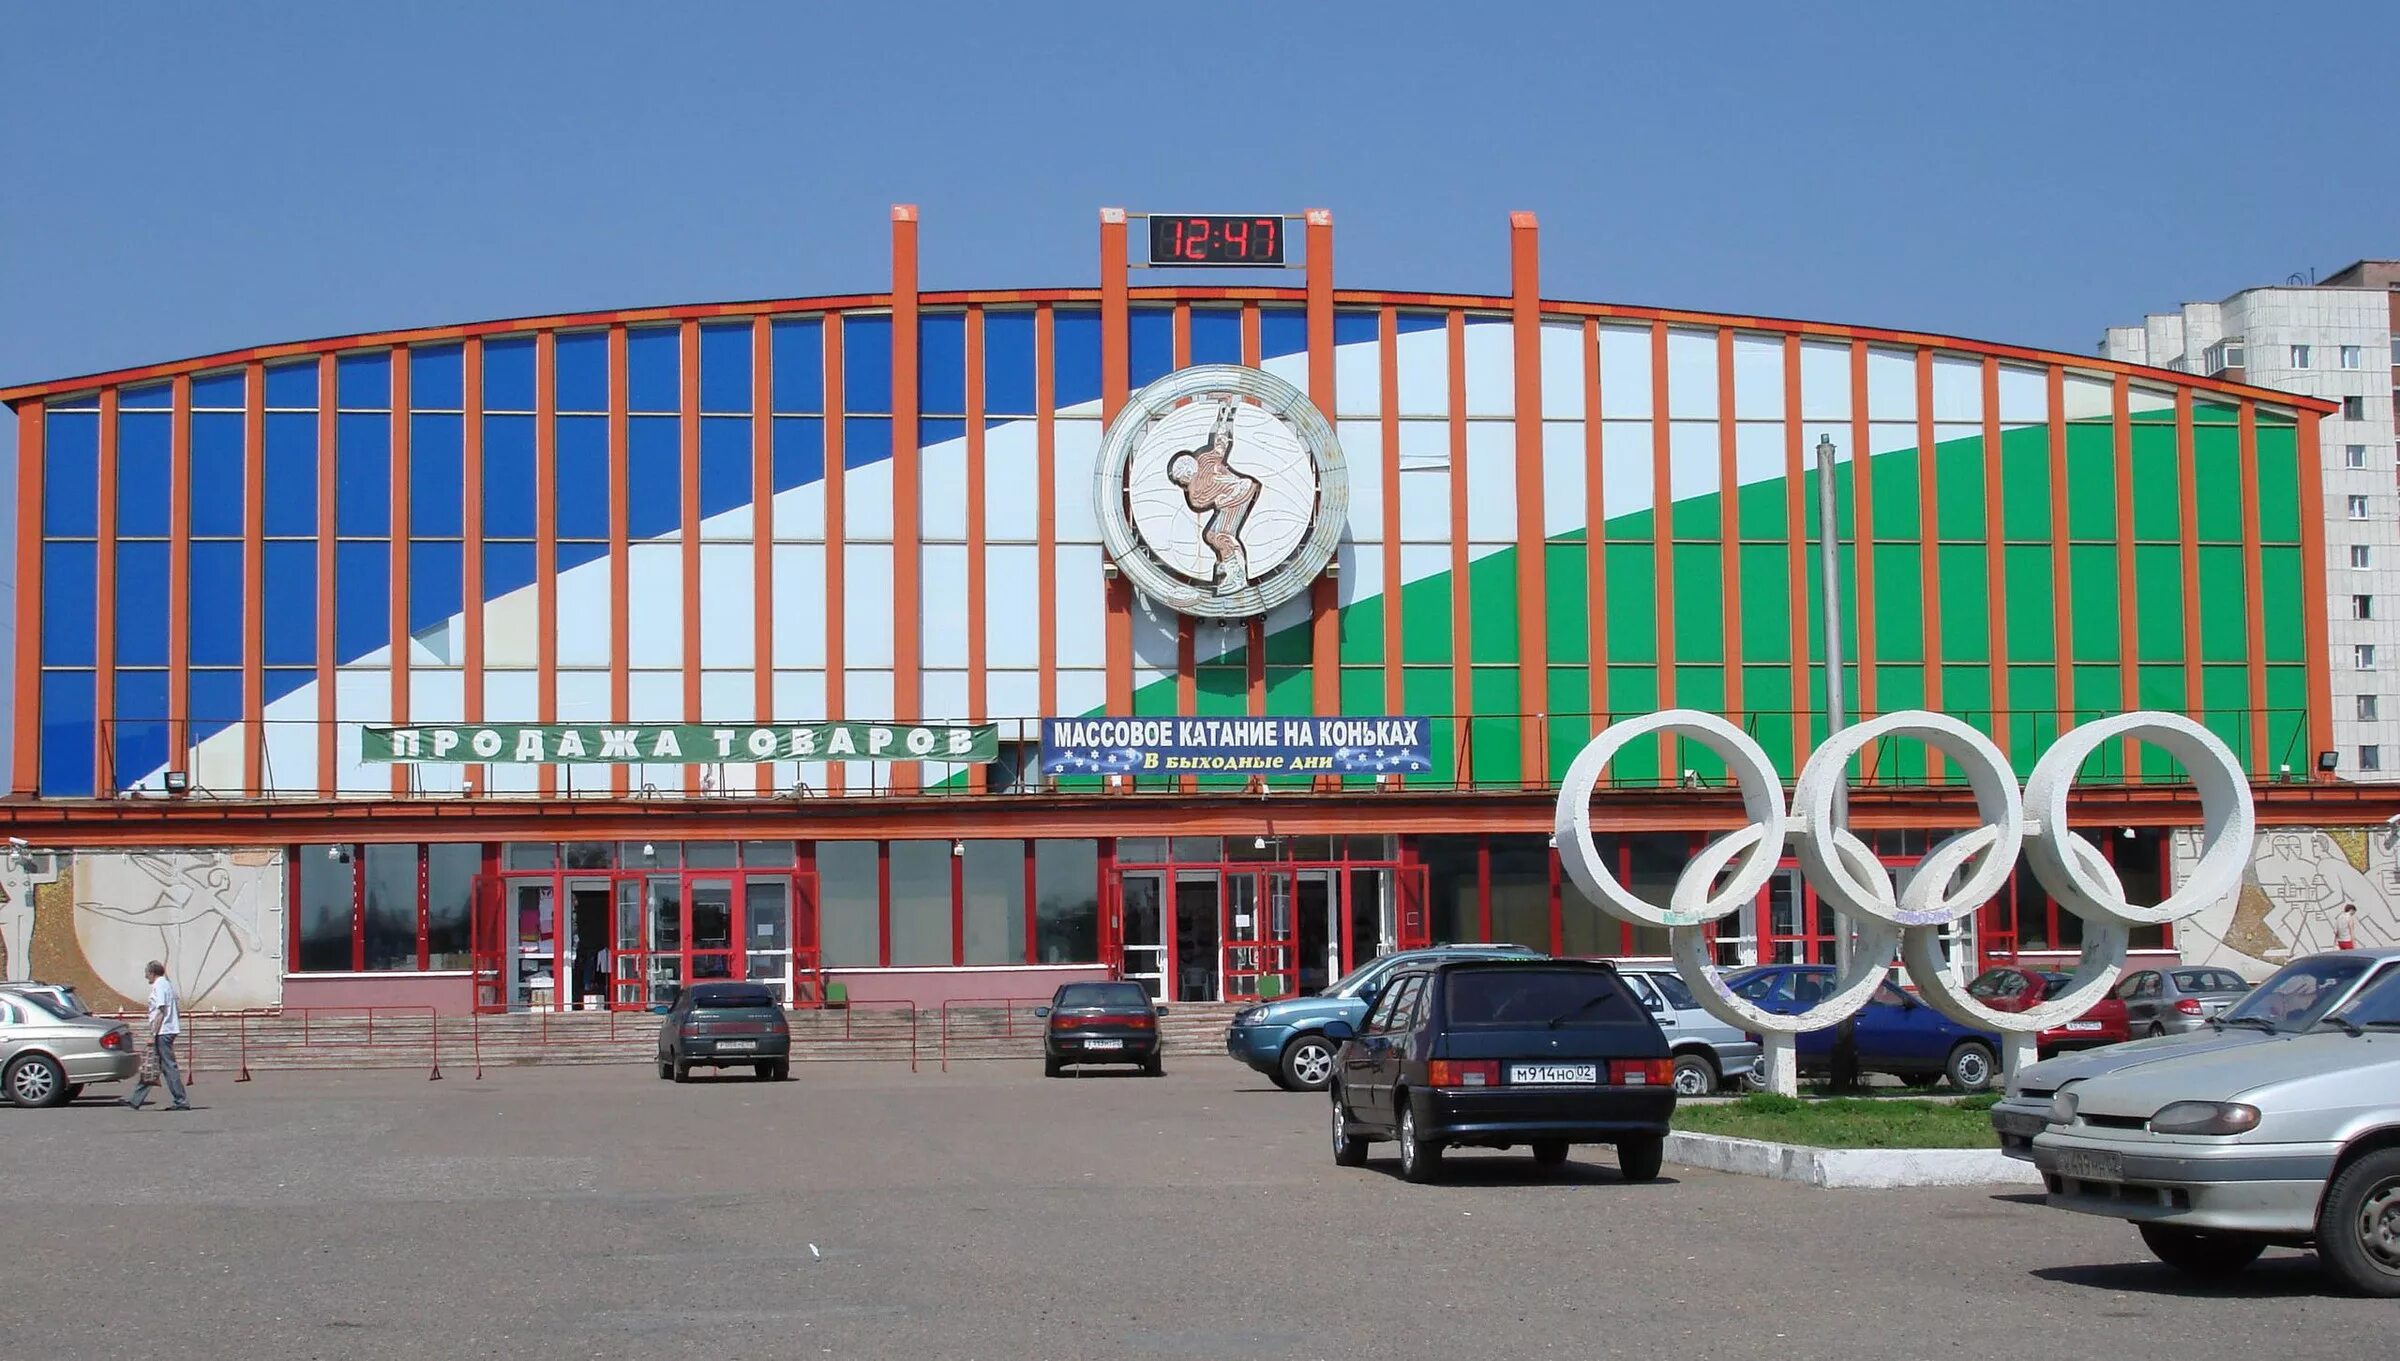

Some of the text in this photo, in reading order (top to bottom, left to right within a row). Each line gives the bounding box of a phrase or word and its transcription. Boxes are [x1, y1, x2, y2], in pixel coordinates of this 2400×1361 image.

[1174, 219, 1275, 259] 12:47
[392, 727, 973, 762] ПРОДАЖА ТОВАРОВ
[1054, 720, 1419, 748] МАССОВОЕ КАТАНИЕ НА КОНЬКАХ
[1143, 752, 1160, 769] В
[1289, 757, 1334, 770] дни
